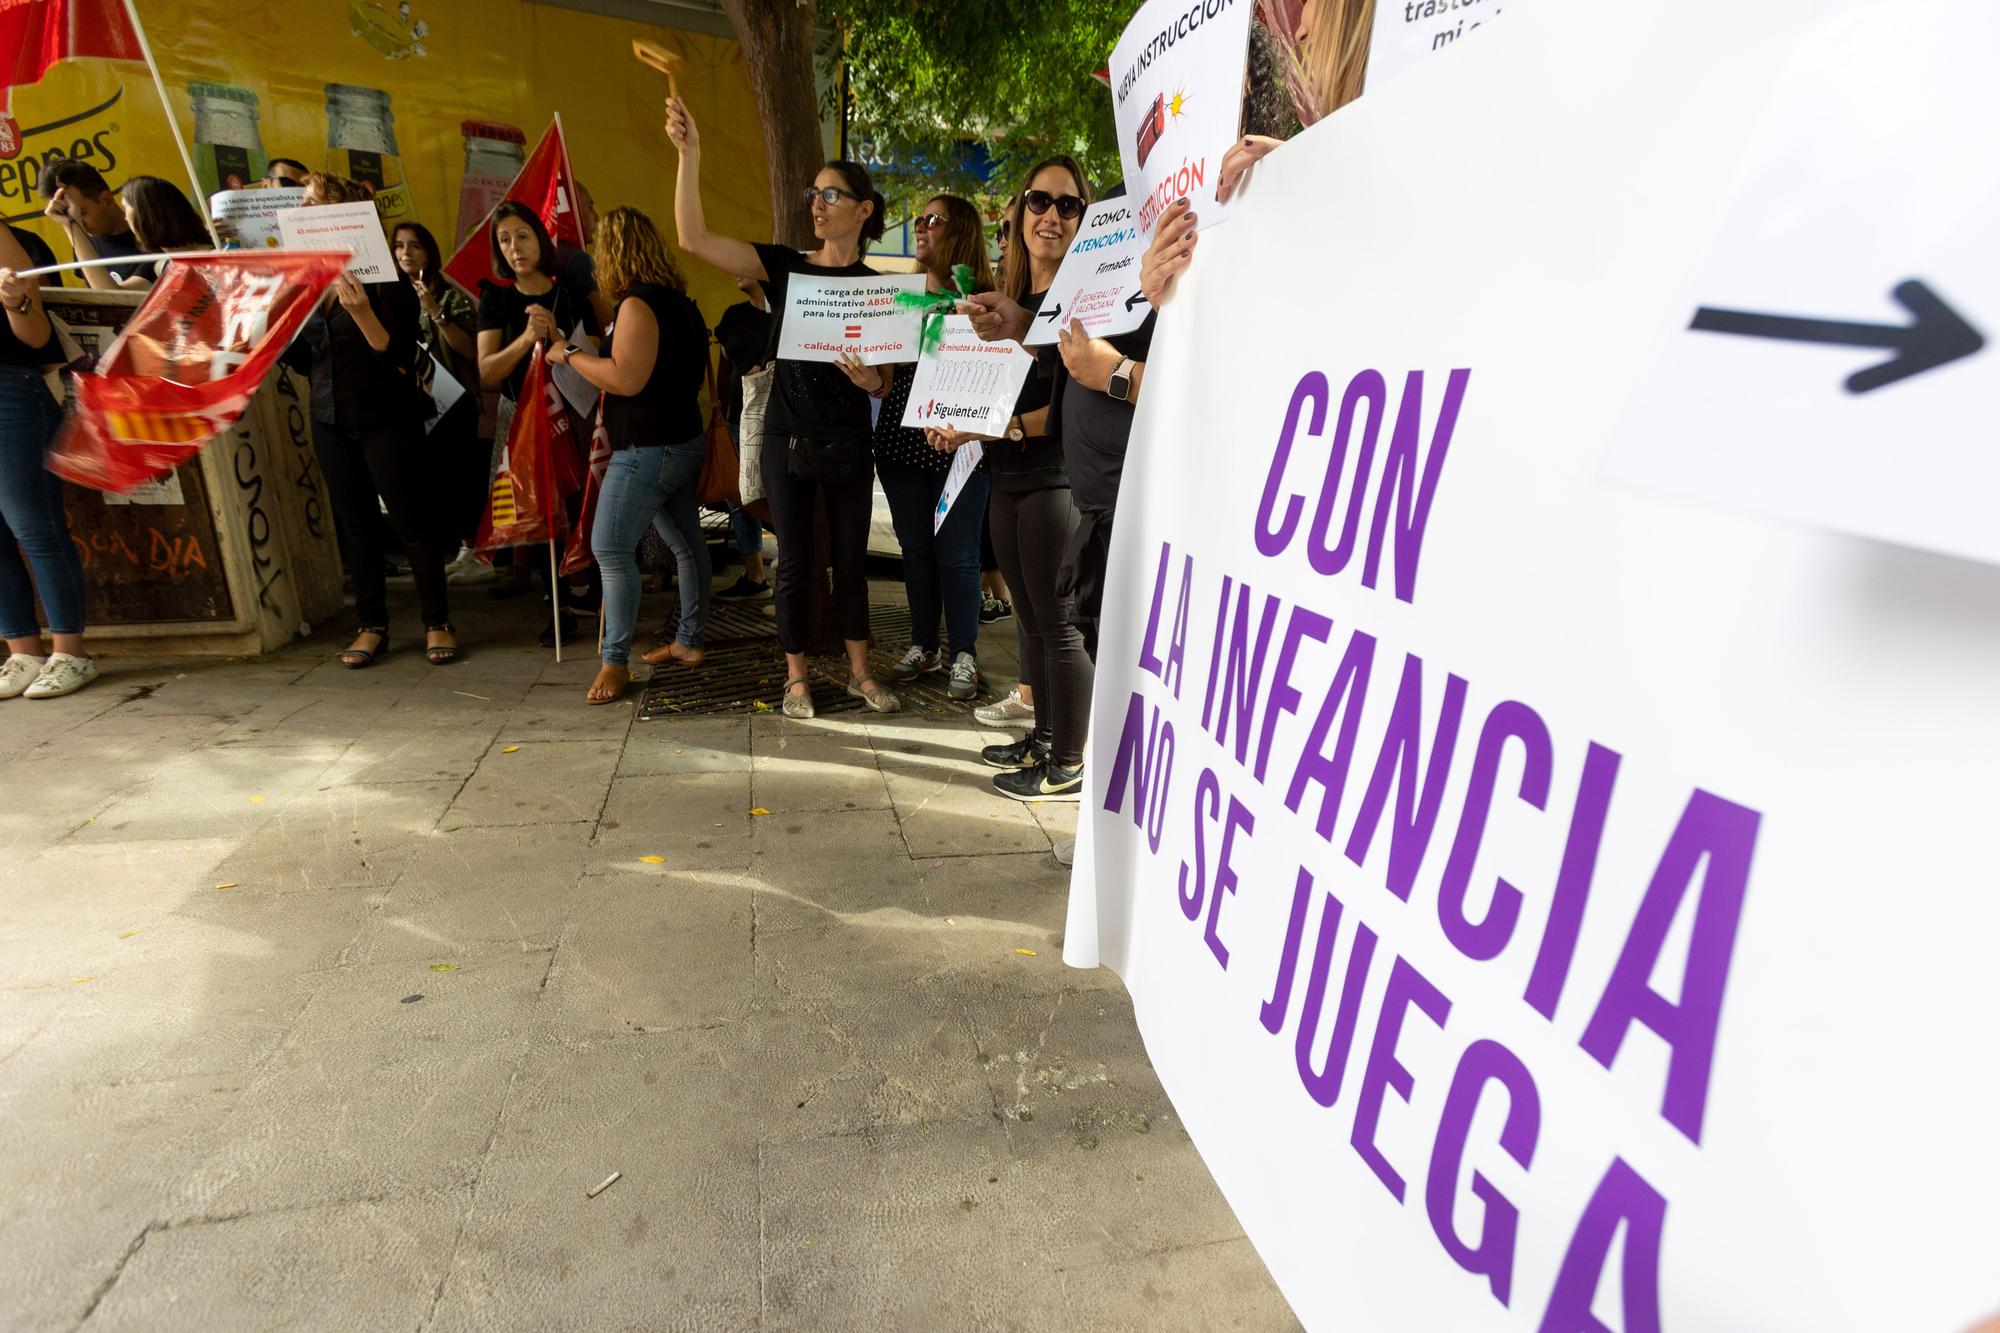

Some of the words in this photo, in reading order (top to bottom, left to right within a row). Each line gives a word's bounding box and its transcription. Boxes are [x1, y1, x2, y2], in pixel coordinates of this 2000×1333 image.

[1117, 64, 1137, 109] NUEVA
[0, 130, 117, 204] epes
[1138, 156, 1205, 234] DESTRUCCIÓN
[1091, 208, 1126, 228] COMO
[1071, 228, 1128, 254] ATENCIÓN
[1095, 255, 1134, 275] Firmado:
[796, 297, 865, 307] administrativo
[824, 288, 850, 298] carga
[852, 287, 864, 296] de
[866, 286, 899, 296] trabajo
[1080, 286, 1124, 304] GENERALITAT
[803, 309, 825, 318] para
[826, 310, 840, 318] los
[804, 342, 843, 352] calidad
[845, 343, 861, 353] del
[864, 341, 902, 352] servicio
[947, 343, 971, 352] minutos
[976, 343, 984, 352] la
[984, 345, 1013, 354] semana
[933, 402, 990, 419] Siguiente!!!
[1254, 367, 1472, 604] CON
[1103, 691, 1175, 856] NO
[1178, 766, 1256, 972] SE
[1138, 541, 1193, 701] LA
[1201, 574, 1764, 1149] INFANCIA
